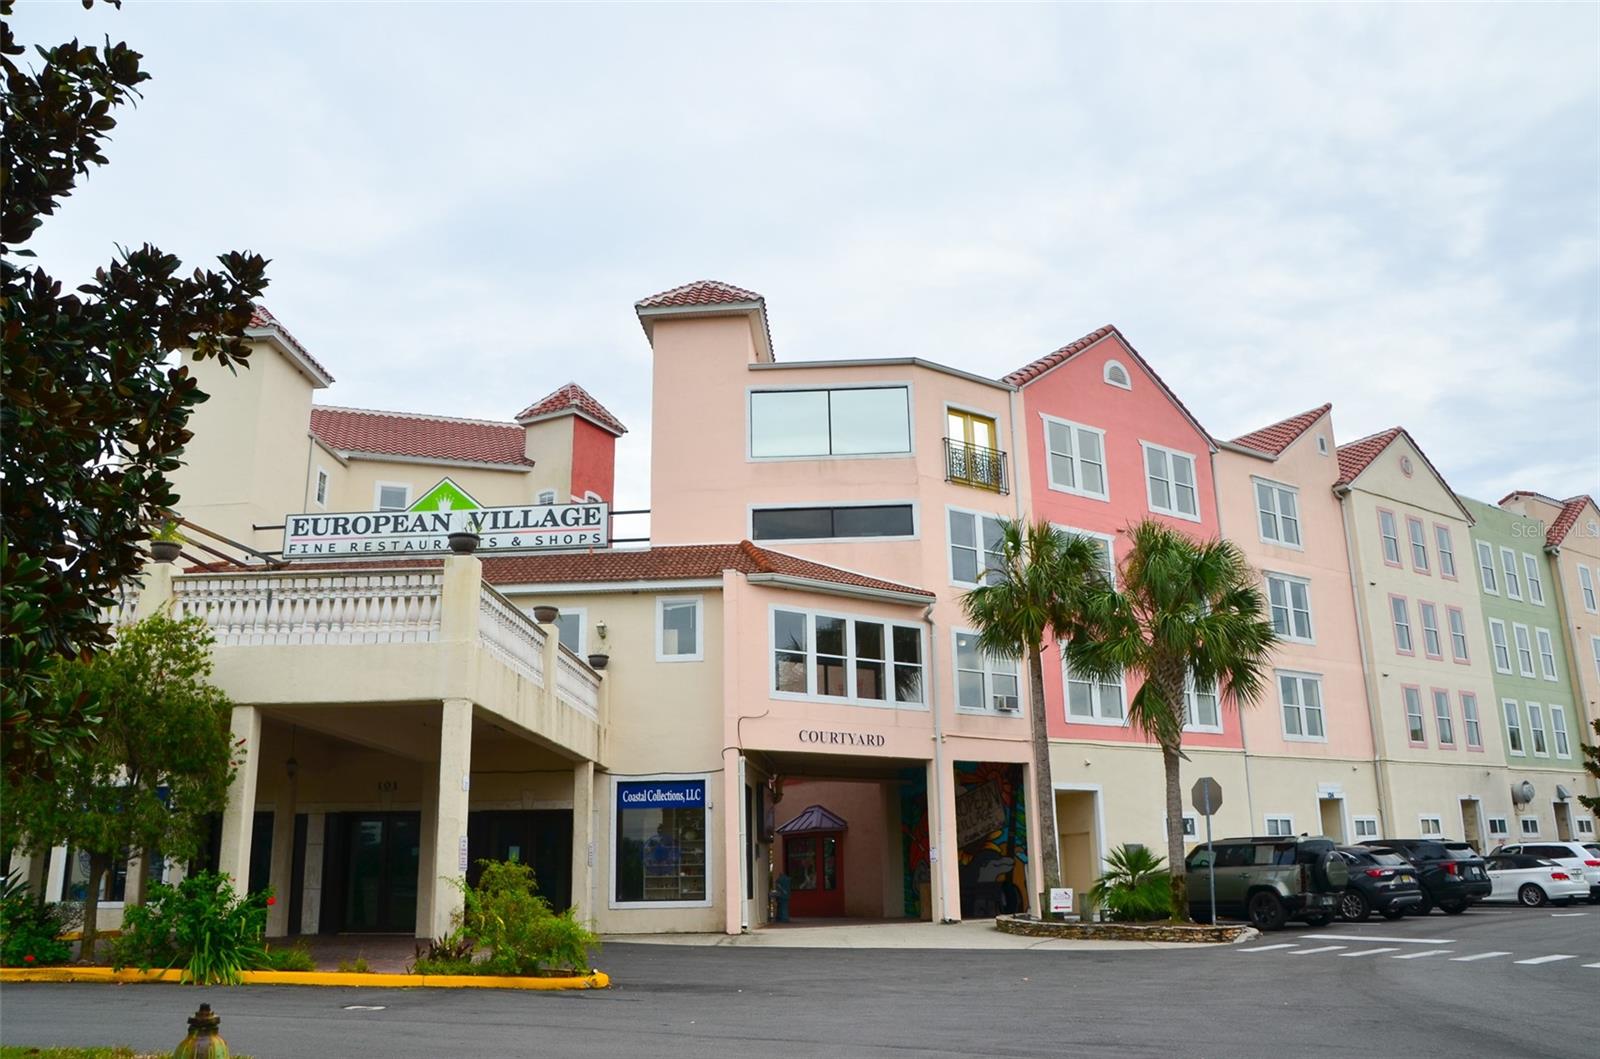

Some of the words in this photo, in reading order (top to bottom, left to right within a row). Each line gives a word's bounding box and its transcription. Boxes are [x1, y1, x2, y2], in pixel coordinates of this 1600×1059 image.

[290, 512, 453, 537] EUROPEAN
[468, 507, 601, 532] VILLAGE
[288, 542, 337, 554] FINE
[350, 535, 498, 552] RESTAURTS
[511, 536, 521, 547] &
[535, 533, 601, 546] SHOPS
[798, 729, 885, 747] COURTYARD
[622, 790, 646, 803] Coastal
[648, 789, 685, 803] Collections,
[686, 789, 702, 801] LLC
